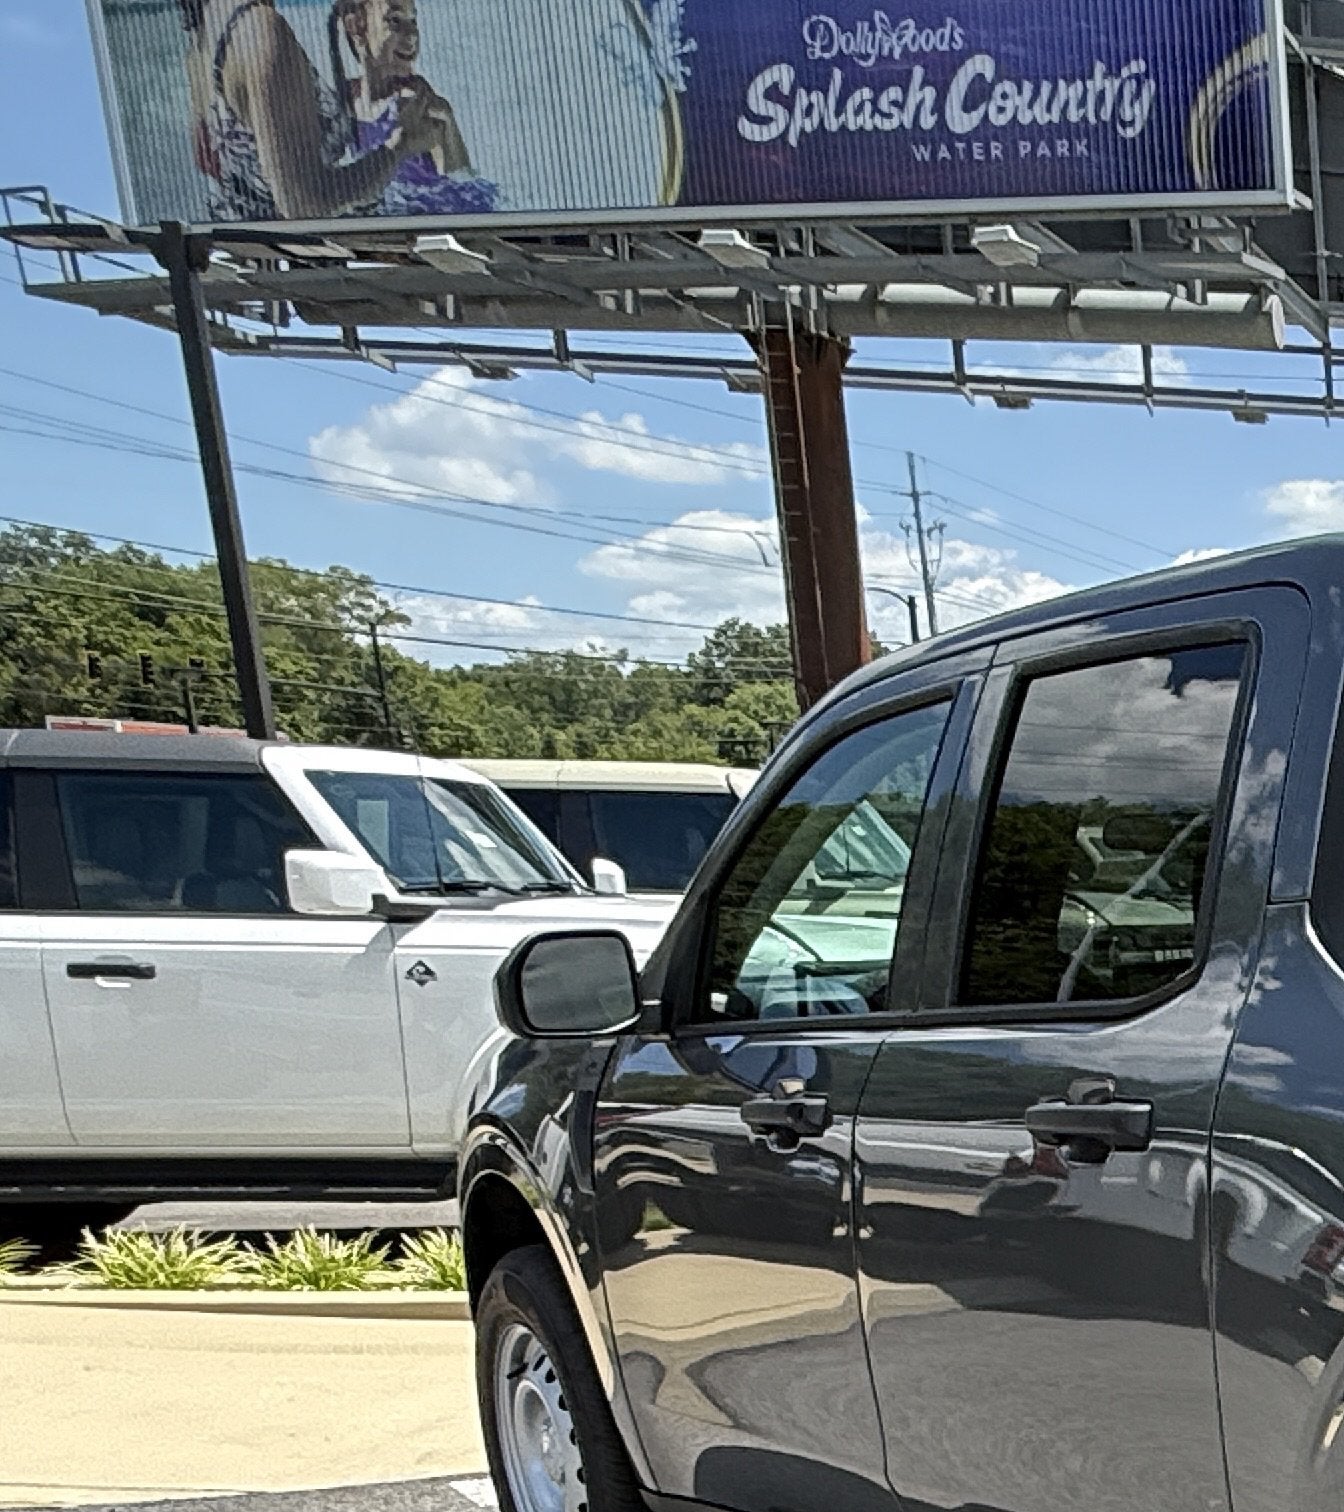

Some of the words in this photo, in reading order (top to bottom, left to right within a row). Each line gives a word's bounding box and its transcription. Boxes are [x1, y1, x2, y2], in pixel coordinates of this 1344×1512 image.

[737, 63, 938, 147] Splash
[944, 54, 1156, 137] Country
[911, 142, 1003, 161] WATER
[1018, 138, 1089, 160] PARK
